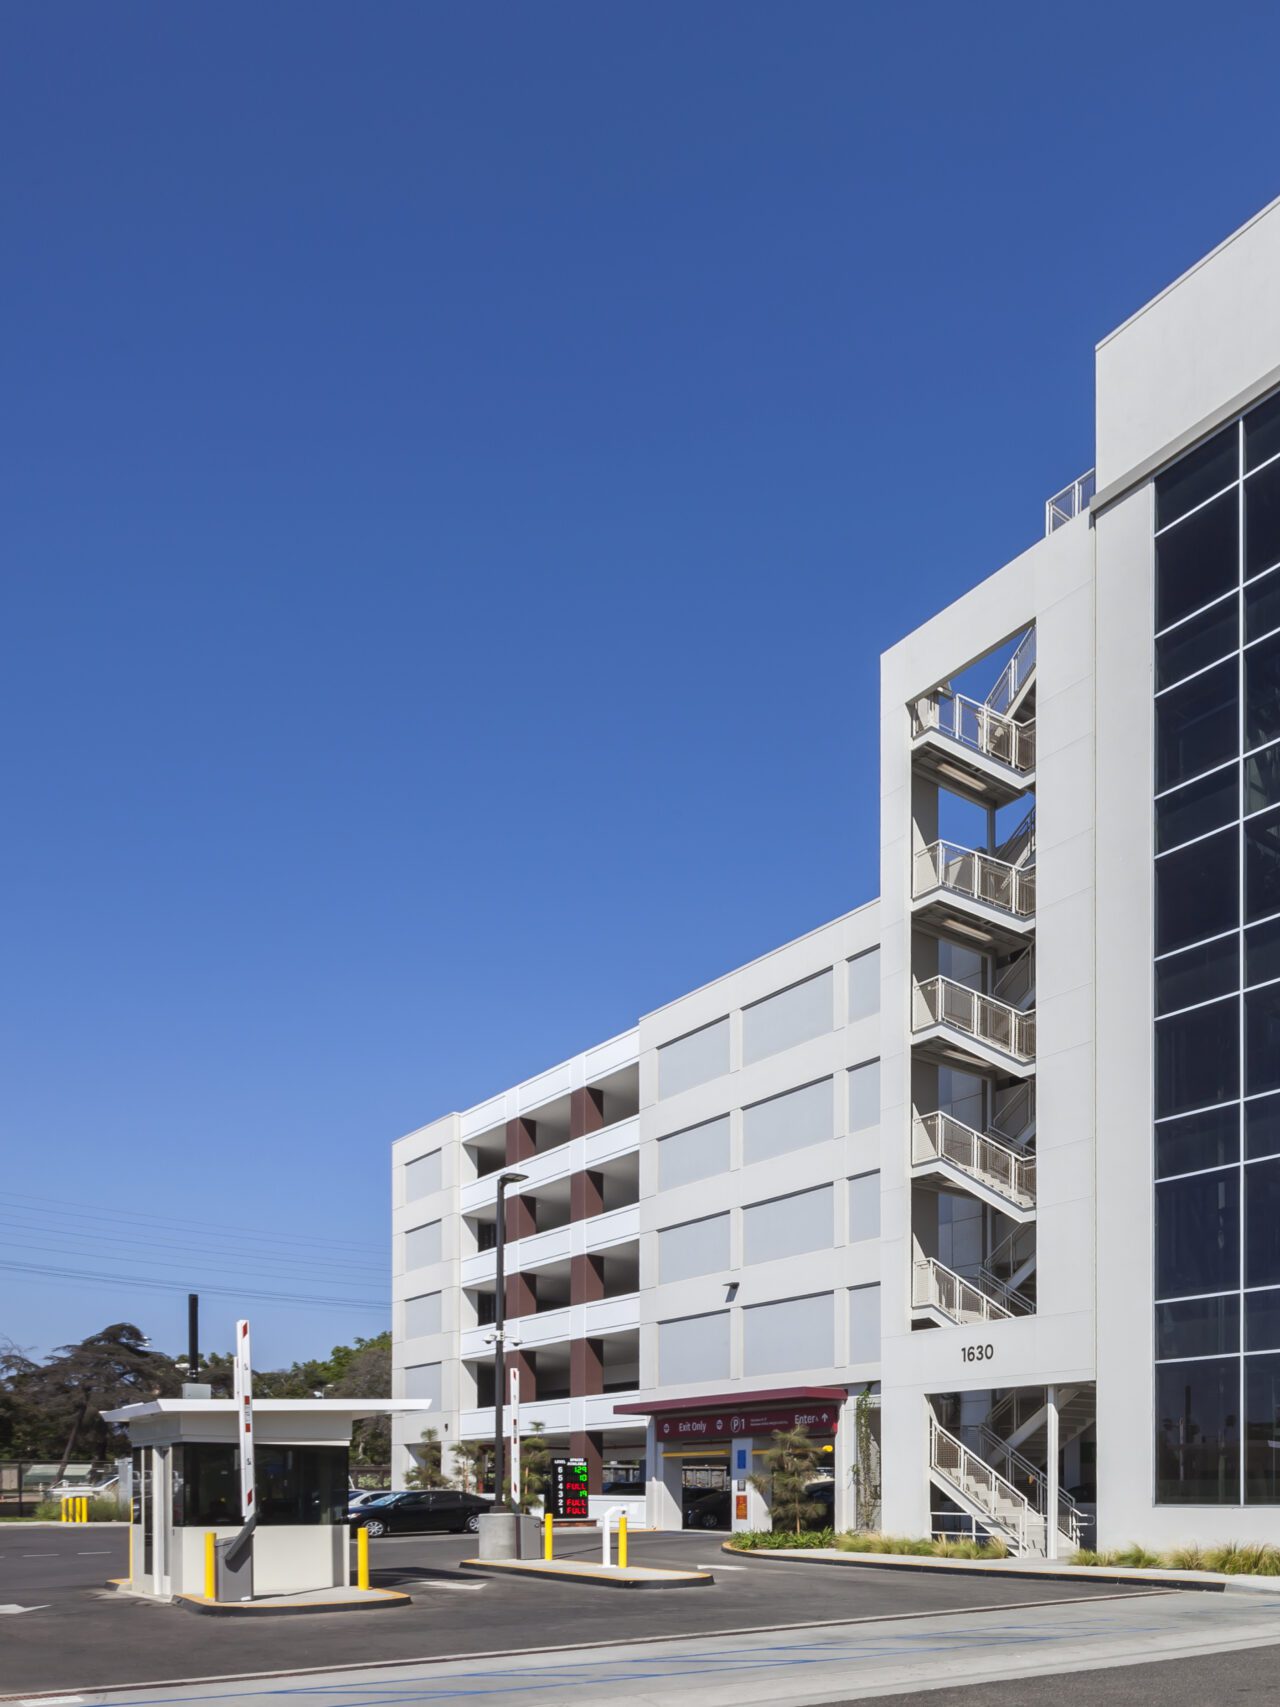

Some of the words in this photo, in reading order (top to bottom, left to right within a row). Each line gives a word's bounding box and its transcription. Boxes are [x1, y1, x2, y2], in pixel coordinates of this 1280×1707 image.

[961, 1344, 994, 1362] 1630
[794, 1414, 815, 1425] Enter
[679, 1422, 691, 1432] Exit
[692, 1420, 707, 1433] Only
[566, 1482, 586, 1490] FULL
